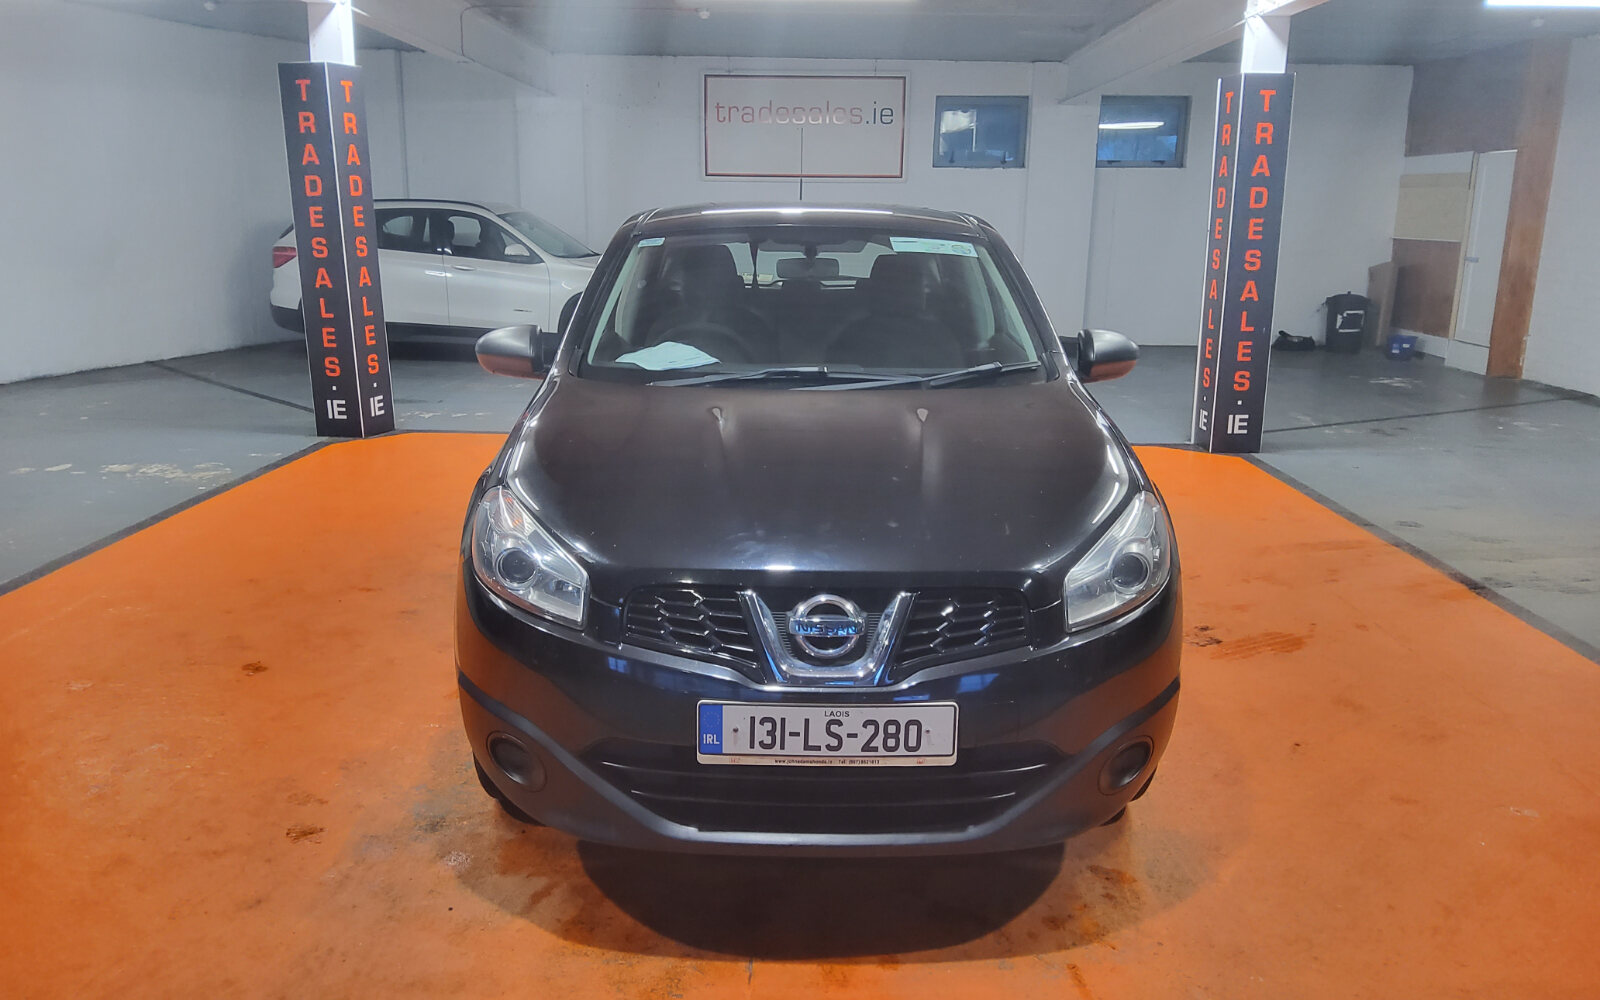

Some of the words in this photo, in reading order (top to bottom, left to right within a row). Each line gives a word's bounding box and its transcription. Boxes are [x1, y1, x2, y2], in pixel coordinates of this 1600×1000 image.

[714, 99, 894, 125] tradesales.ie
[824, 710, 850, 718] LAOIS
[702, 733, 720, 745] IRL
[749, 716, 923, 753] 131-LS-280
